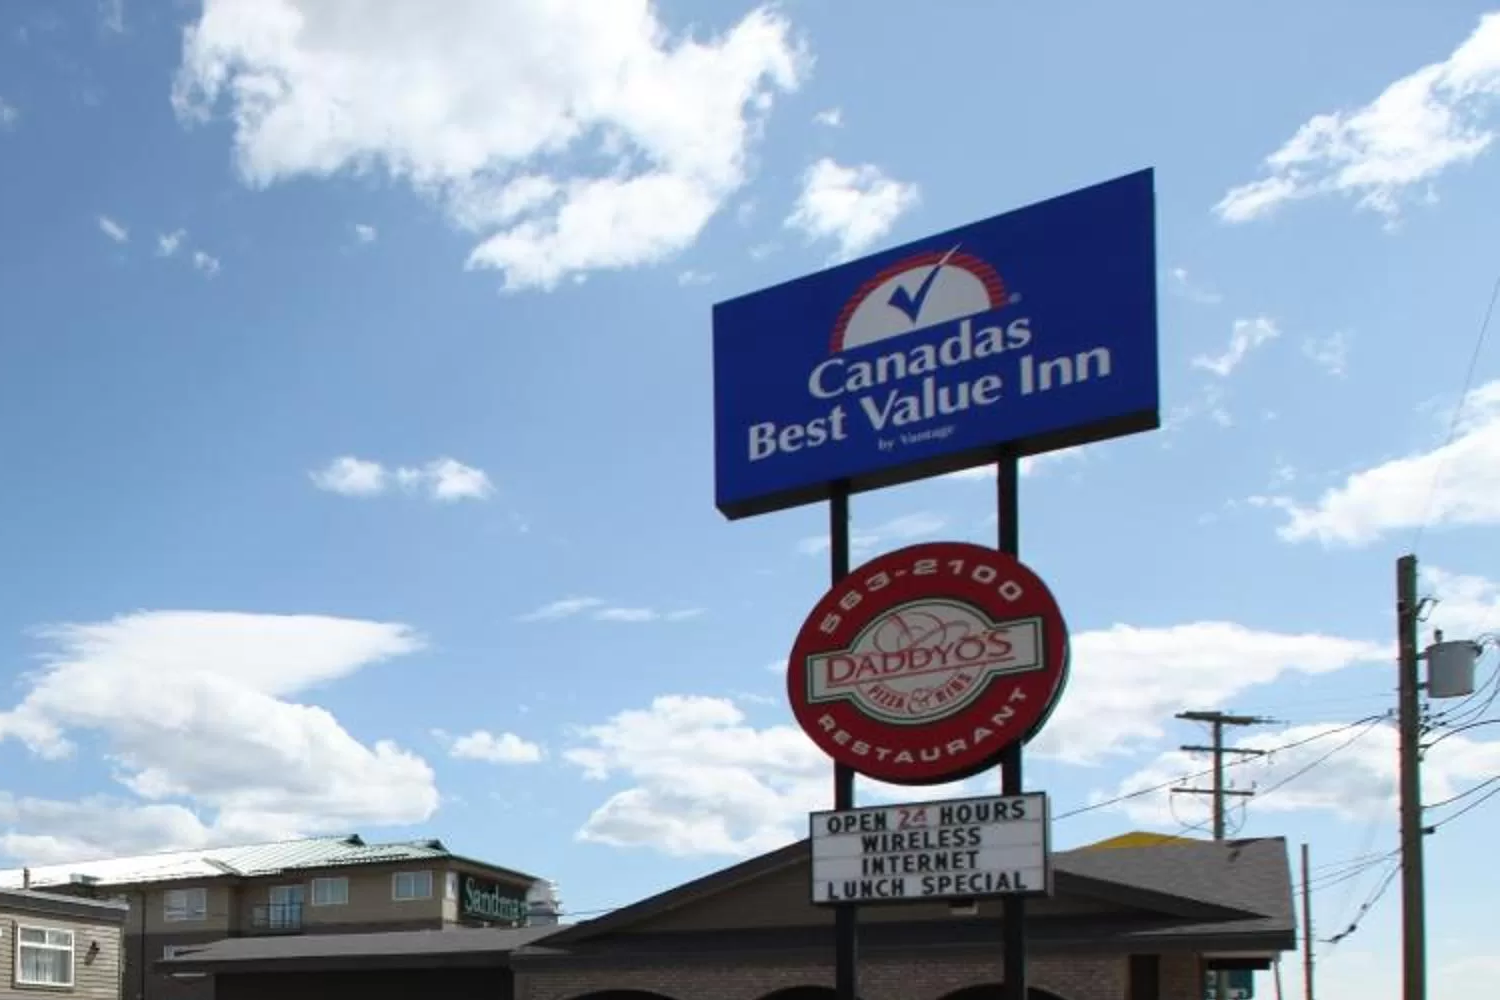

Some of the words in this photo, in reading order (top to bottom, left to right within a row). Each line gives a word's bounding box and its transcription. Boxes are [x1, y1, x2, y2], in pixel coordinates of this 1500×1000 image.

[808, 317, 1032, 399] Canadas
[748, 407, 848, 462] Best
[860, 374, 1003, 431] Value
[1019, 346, 1111, 396] Inn
[817, 687, 1028, 764] RESTAURANT
[827, 810, 887, 835] OPEN
[899, 807, 927, 830] 24
[939, 800, 1026, 827] HOURS
[861, 826, 982, 853] WIRELESS
[862, 851, 979, 877] INTERNET
[827, 878, 905, 901] LUNCH
[922, 871, 1028, 896] SPECIAL
